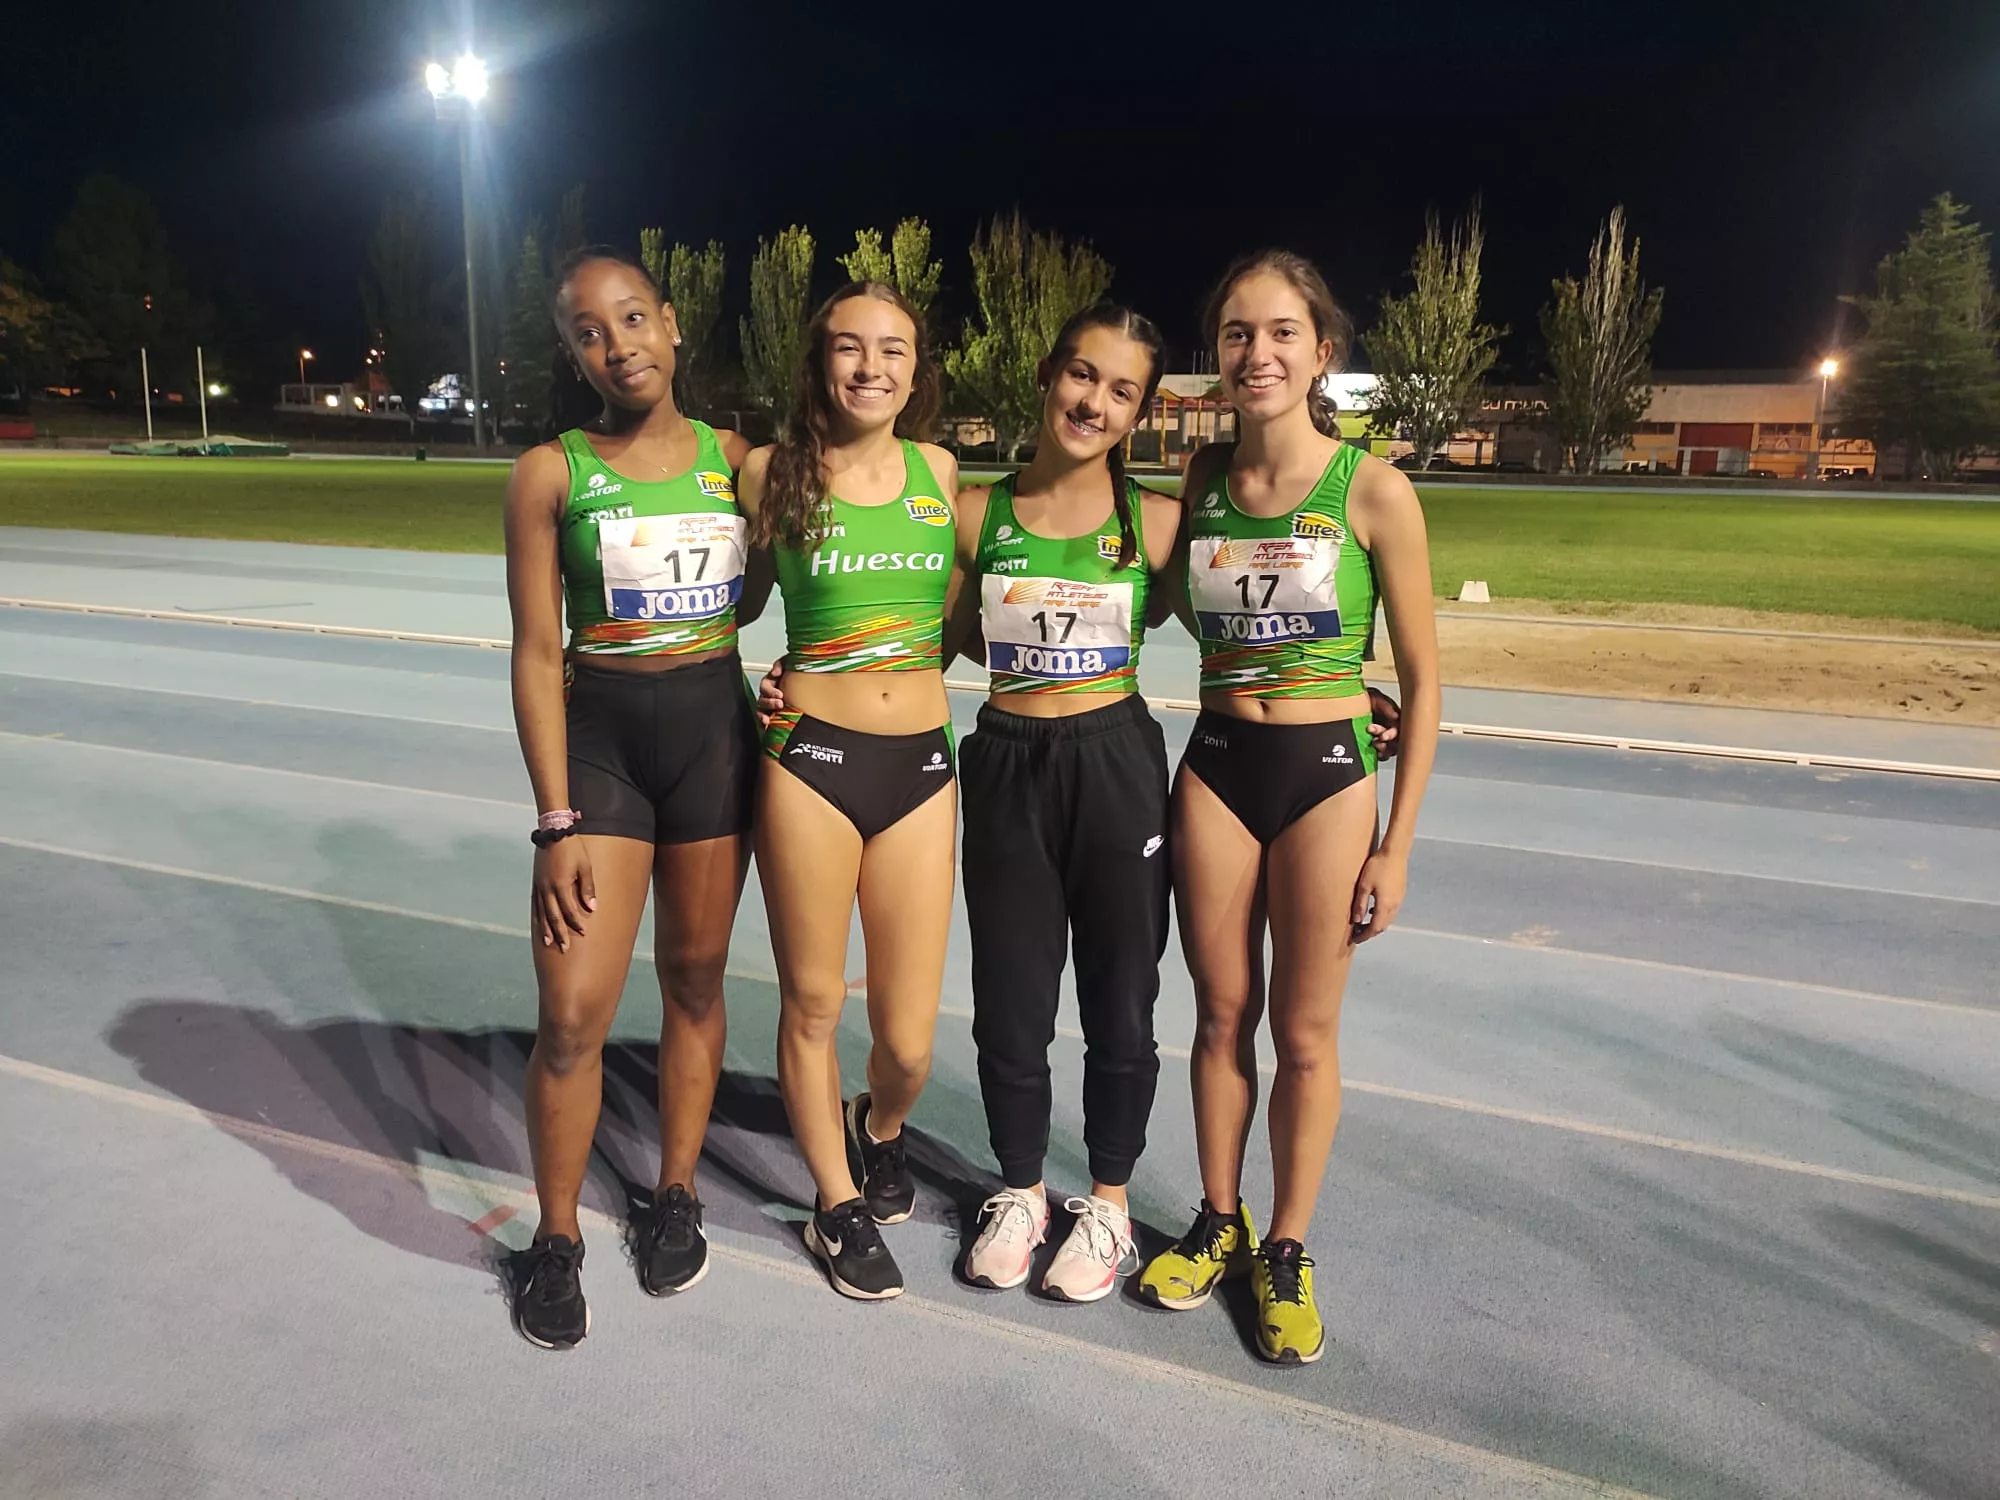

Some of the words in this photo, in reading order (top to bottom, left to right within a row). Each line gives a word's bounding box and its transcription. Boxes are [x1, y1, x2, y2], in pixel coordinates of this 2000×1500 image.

[702, 479, 734, 491] Inte
[911, 503, 949, 516] Intec
[1295, 519, 1344, 538] Intec
[664, 547, 710, 583] 17
[811, 549, 945, 577] Huesca
[1234, 574, 1280, 609] 17
[1031, 611, 1077, 643] 17
[1322, 756, 1354, 764] VIATOR
